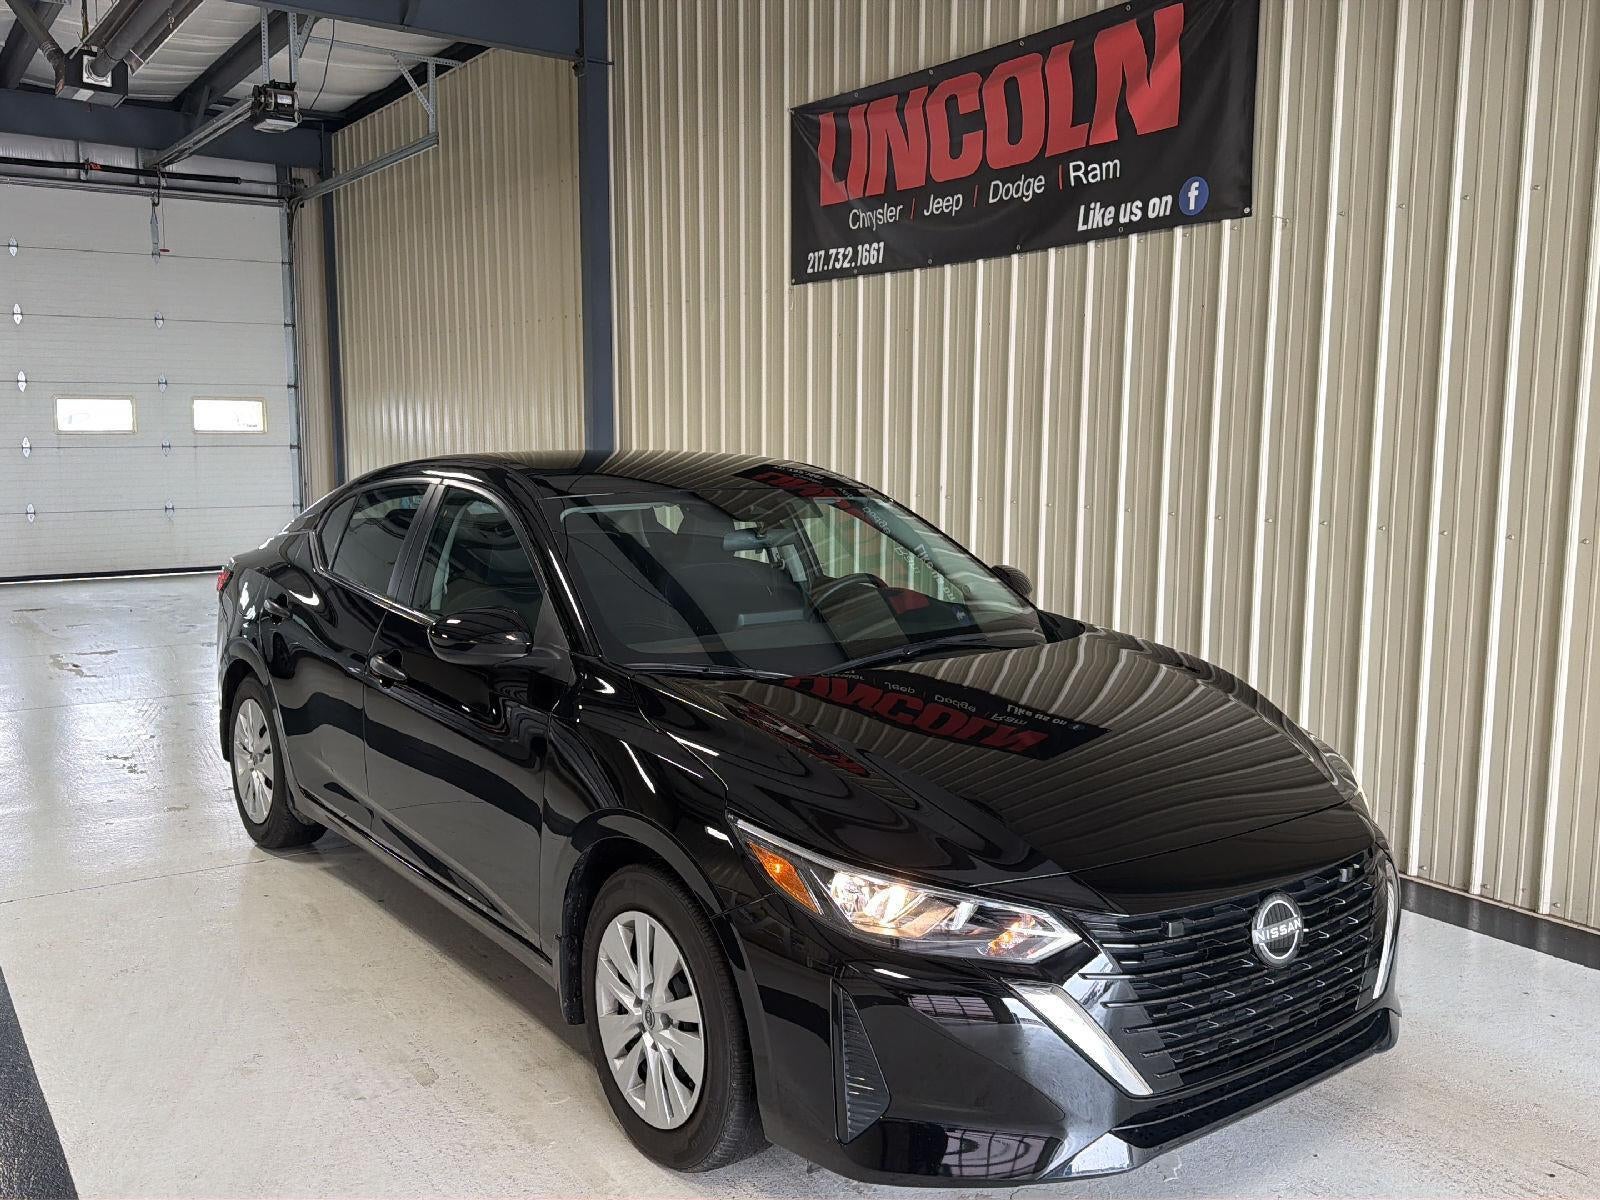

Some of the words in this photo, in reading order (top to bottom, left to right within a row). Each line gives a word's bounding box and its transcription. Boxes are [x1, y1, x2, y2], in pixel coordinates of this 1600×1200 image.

[818, 2, 1185, 206] LINCOLN
[849, 203, 904, 231] Chrysler
[923, 193, 963, 217] Jeep
[988, 174, 1046, 204] Dodge
[1069, 158, 1121, 187] Ram
[1077, 201, 1114, 232] Like
[1119, 198, 1143, 224] us
[1148, 193, 1173, 218] on
[806, 241, 885, 274] 217.732.1661
[1253, 917, 1302, 944] NISSAN
